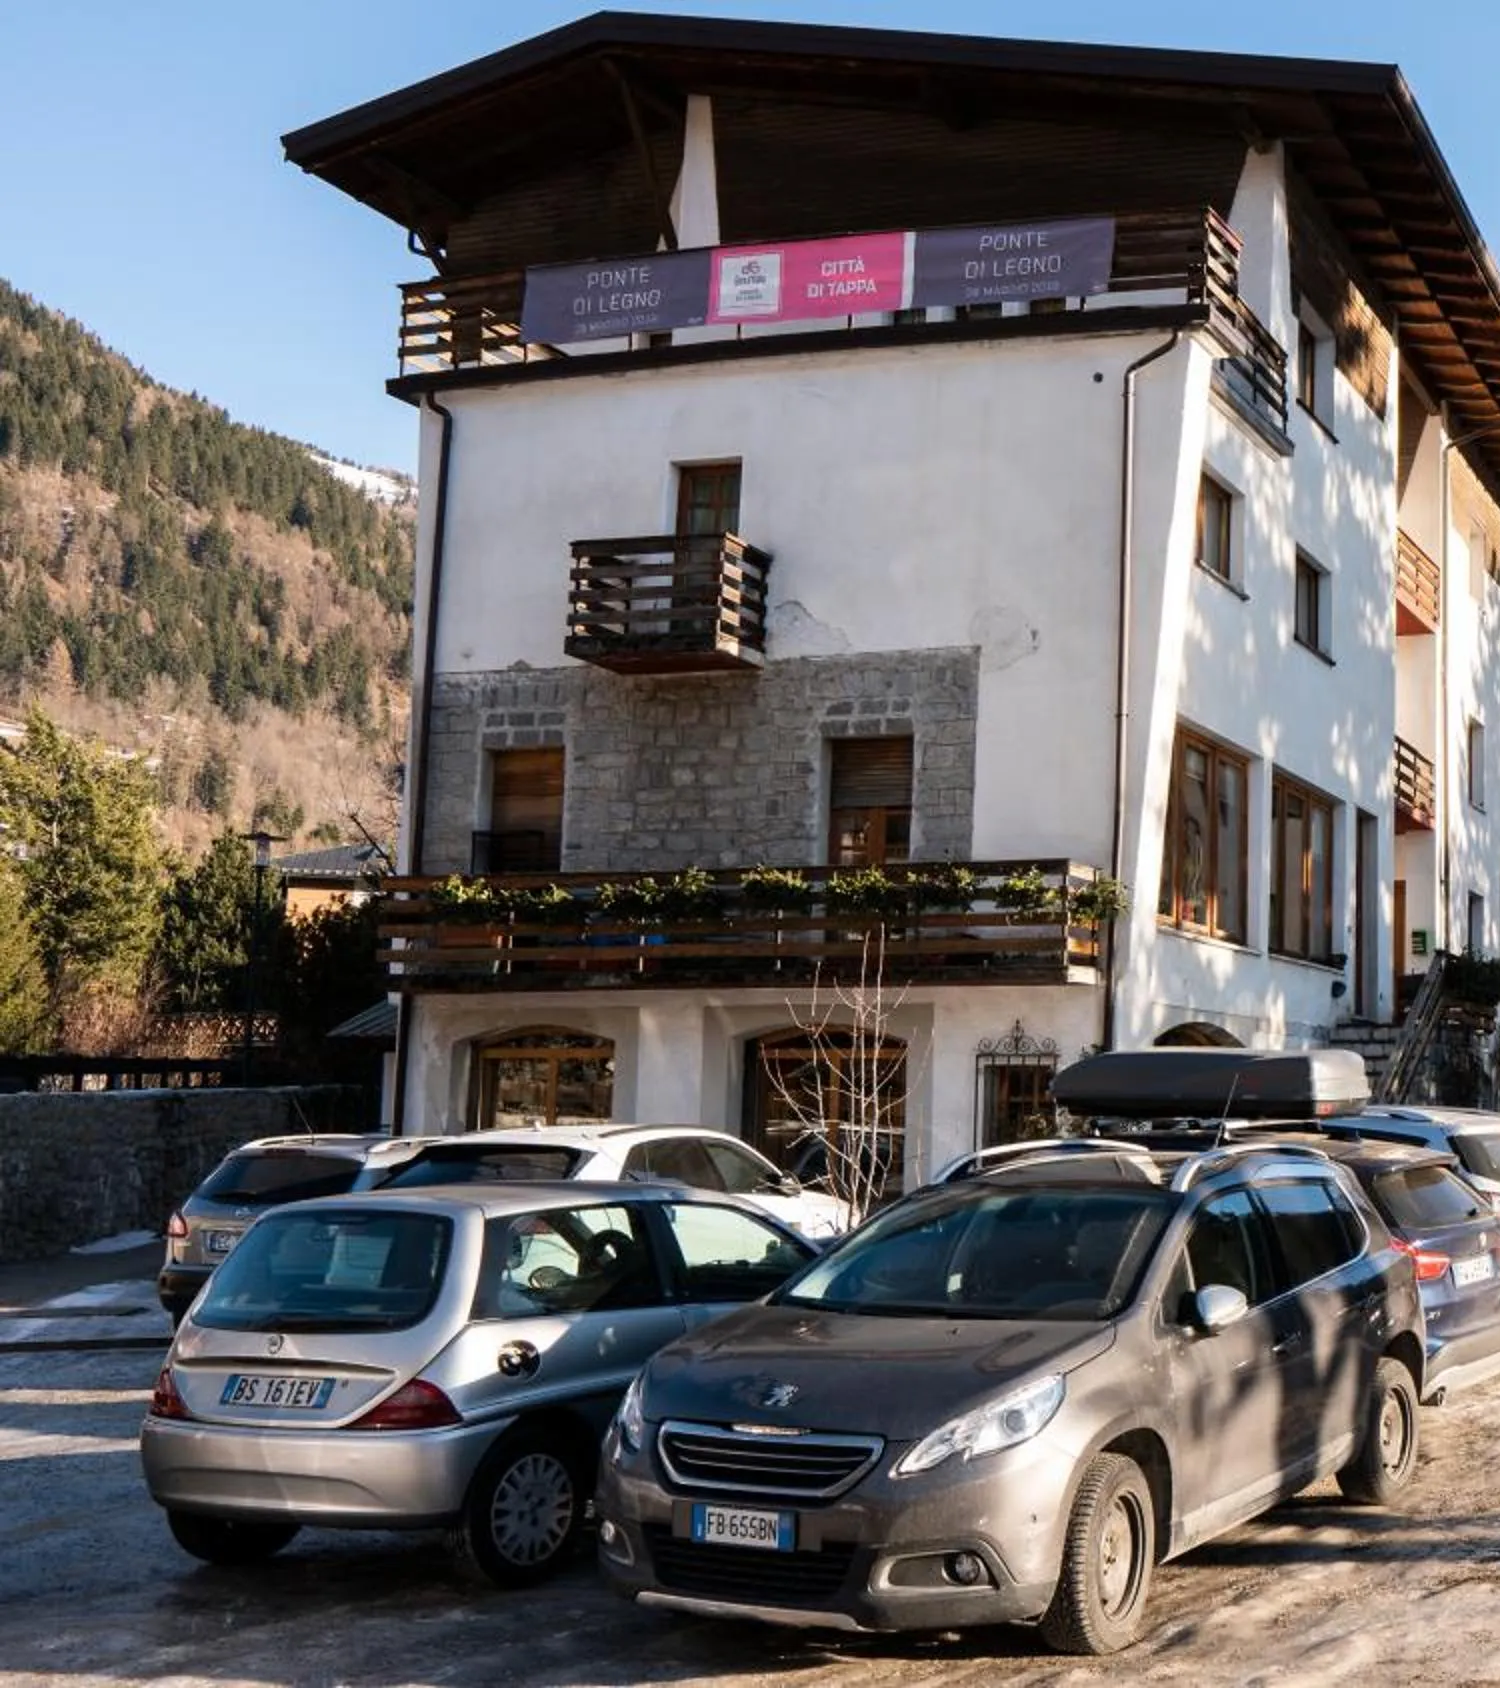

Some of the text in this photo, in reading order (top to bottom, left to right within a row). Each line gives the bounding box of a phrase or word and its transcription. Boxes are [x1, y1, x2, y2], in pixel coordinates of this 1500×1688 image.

[980, 231, 1048, 252] PONTE
[587, 266, 650, 290] PONTE
[821, 256, 865, 277] CITTÀ
[965, 255, 1062, 280] DI LEGNO
[807, 279, 877, 298] DI TAPPA
[573, 289, 661, 315] DI LEGNO
[233, 1376, 322, 1405] BS 161EV
[707, 1512, 725, 1535] FB
[729, 1514, 777, 1542] 655BN
